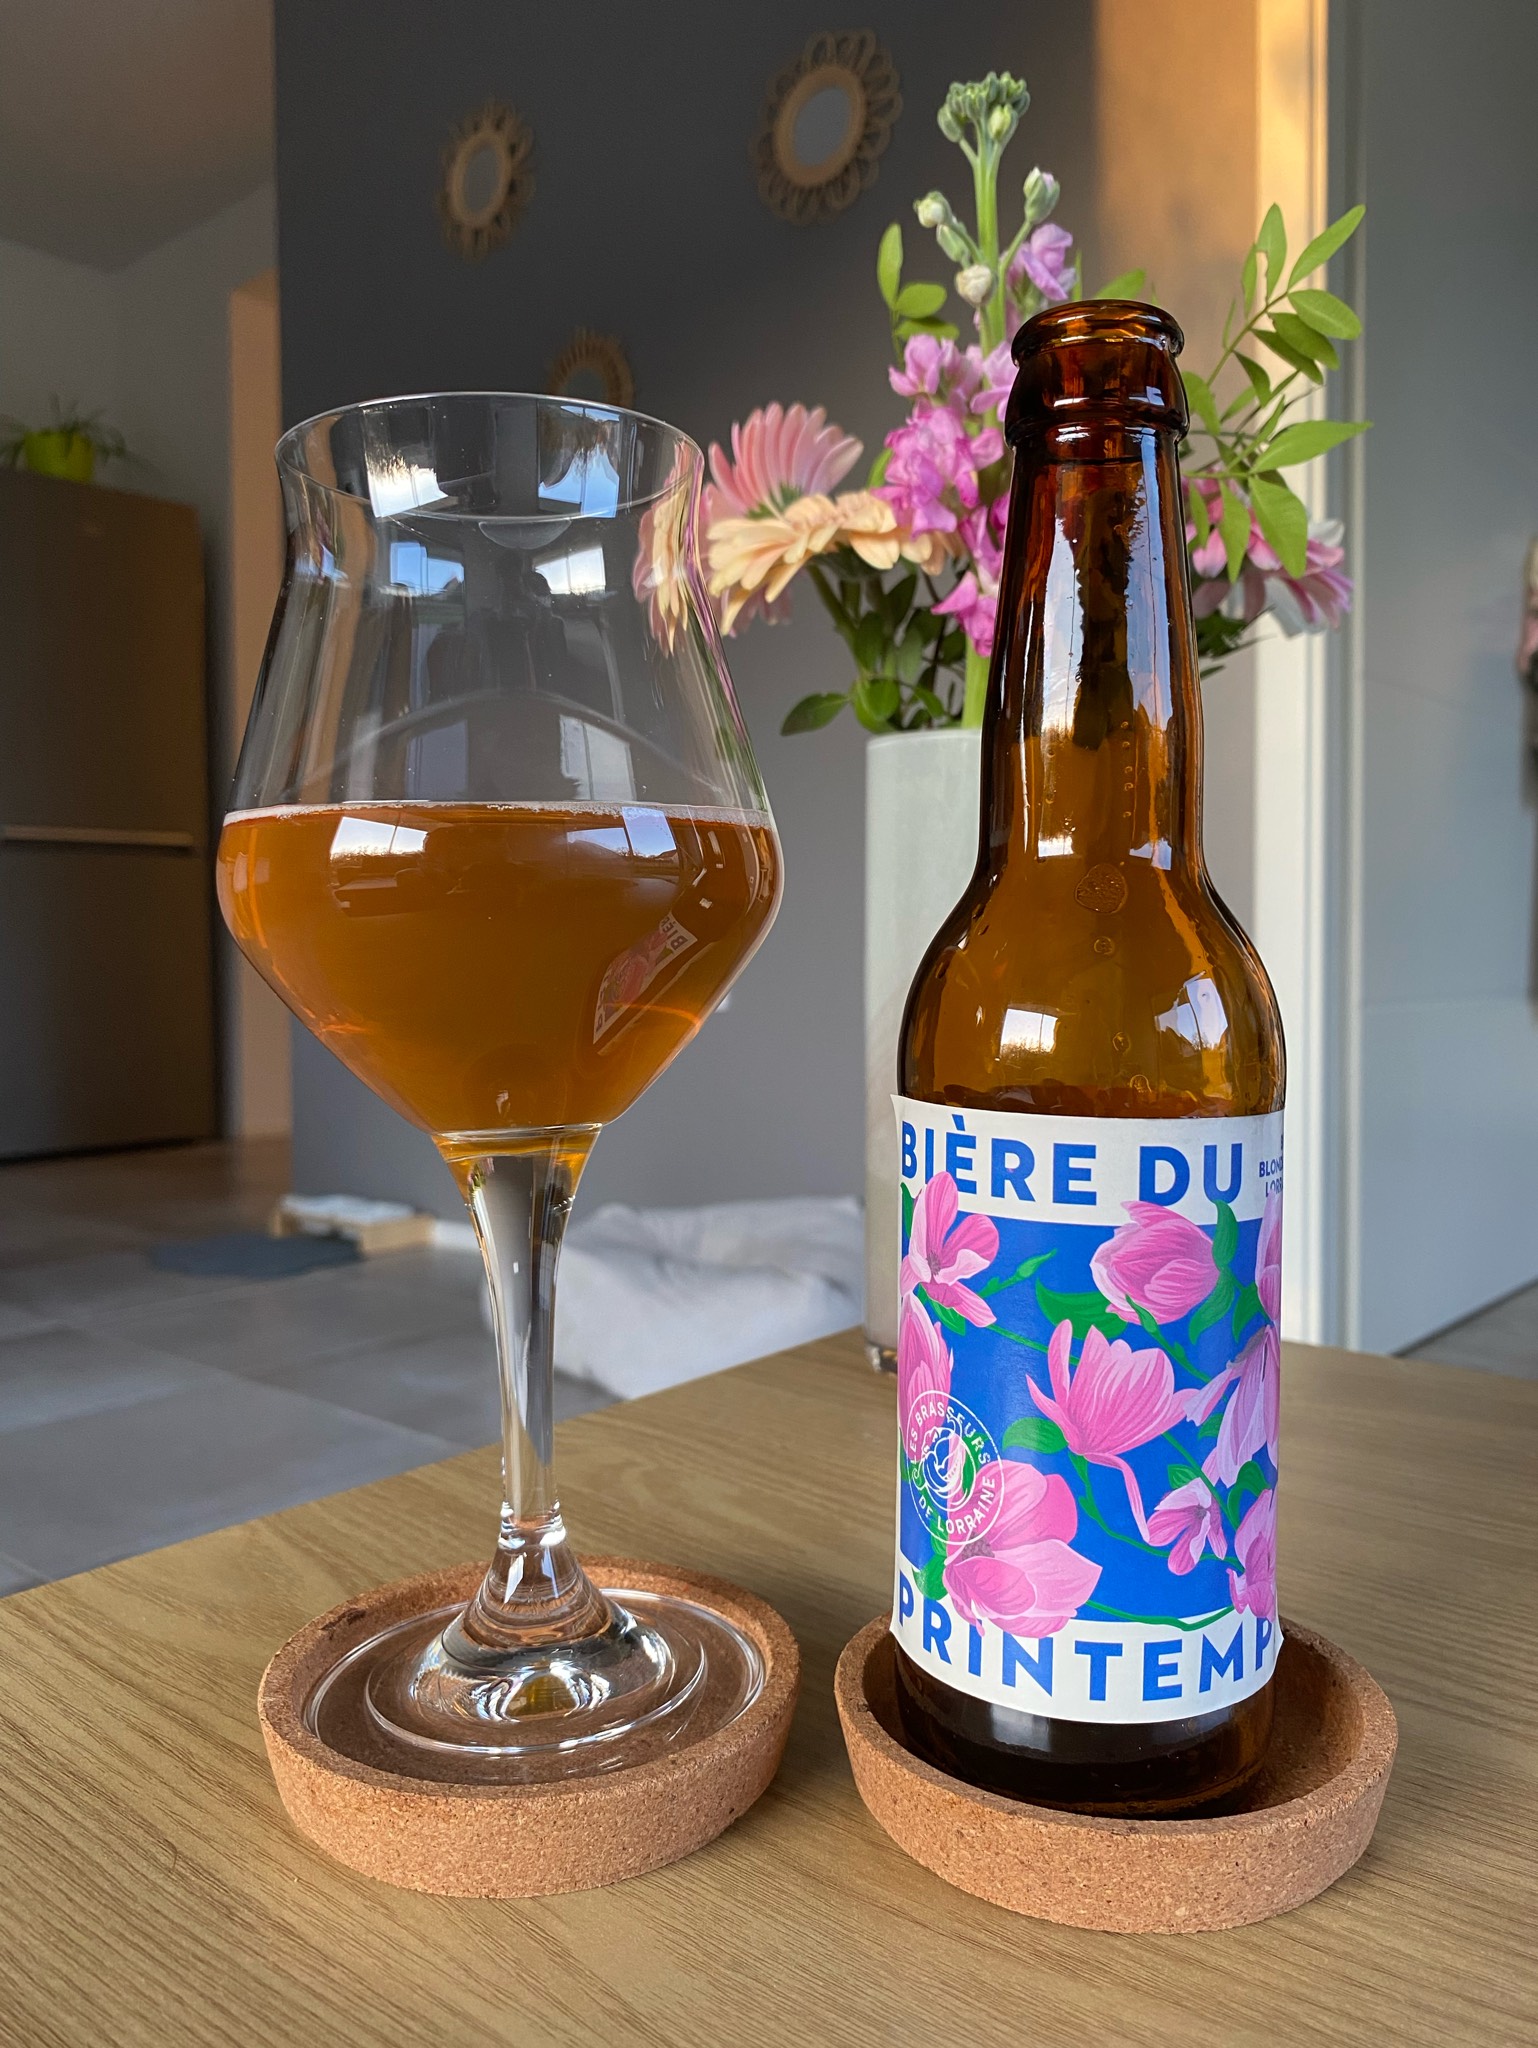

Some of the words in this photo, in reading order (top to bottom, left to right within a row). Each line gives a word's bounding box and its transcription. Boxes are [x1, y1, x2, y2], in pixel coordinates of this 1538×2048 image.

[901, 1114, 1097, 1206] BIÈRE
[1139, 1143, 1242, 1206] DU
[915, 1401, 992, 1466] BRASSEURS
[918, 1494, 934, 1520] DE
[936, 1475, 996, 1535] LORRAINE
